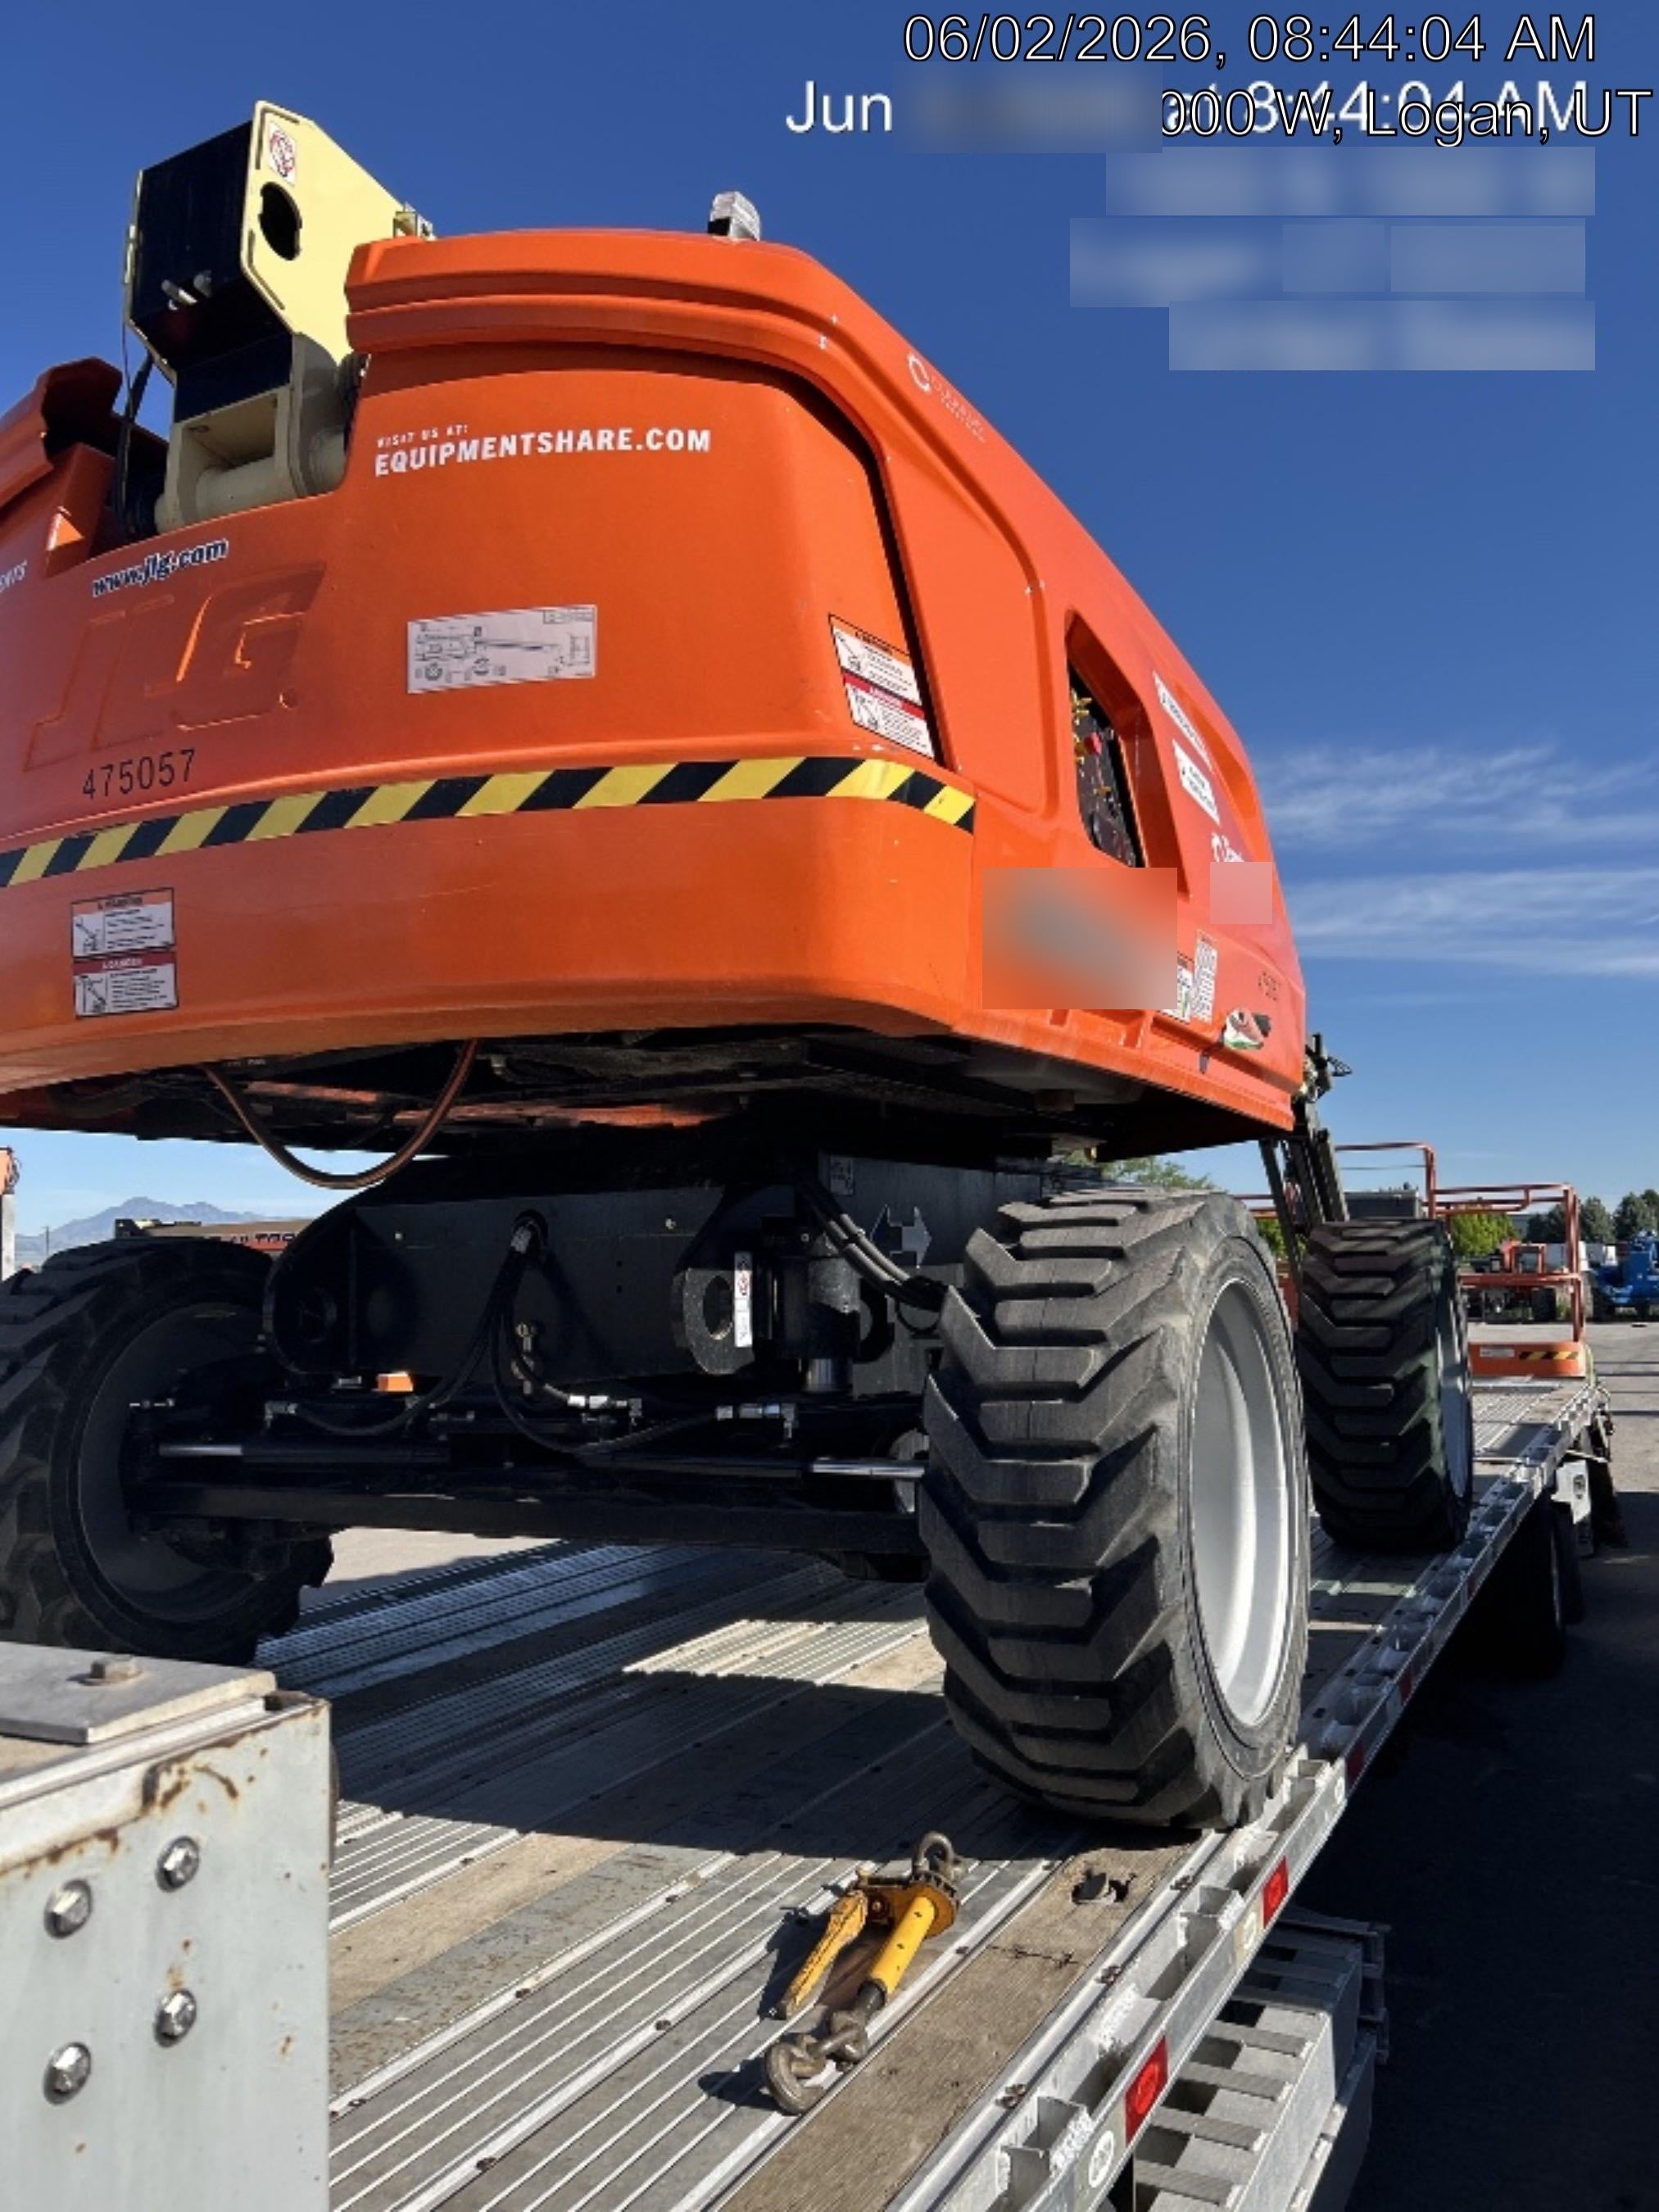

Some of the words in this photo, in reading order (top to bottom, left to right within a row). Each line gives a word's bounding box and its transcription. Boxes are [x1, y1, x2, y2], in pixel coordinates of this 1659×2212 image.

[374, 428, 712, 478] EQUIPMENTSHARE.COM
[421, 427, 439, 441] US
[92, 537, 229, 598] www.jlg.com
[83, 747, 196, 800] 475057
